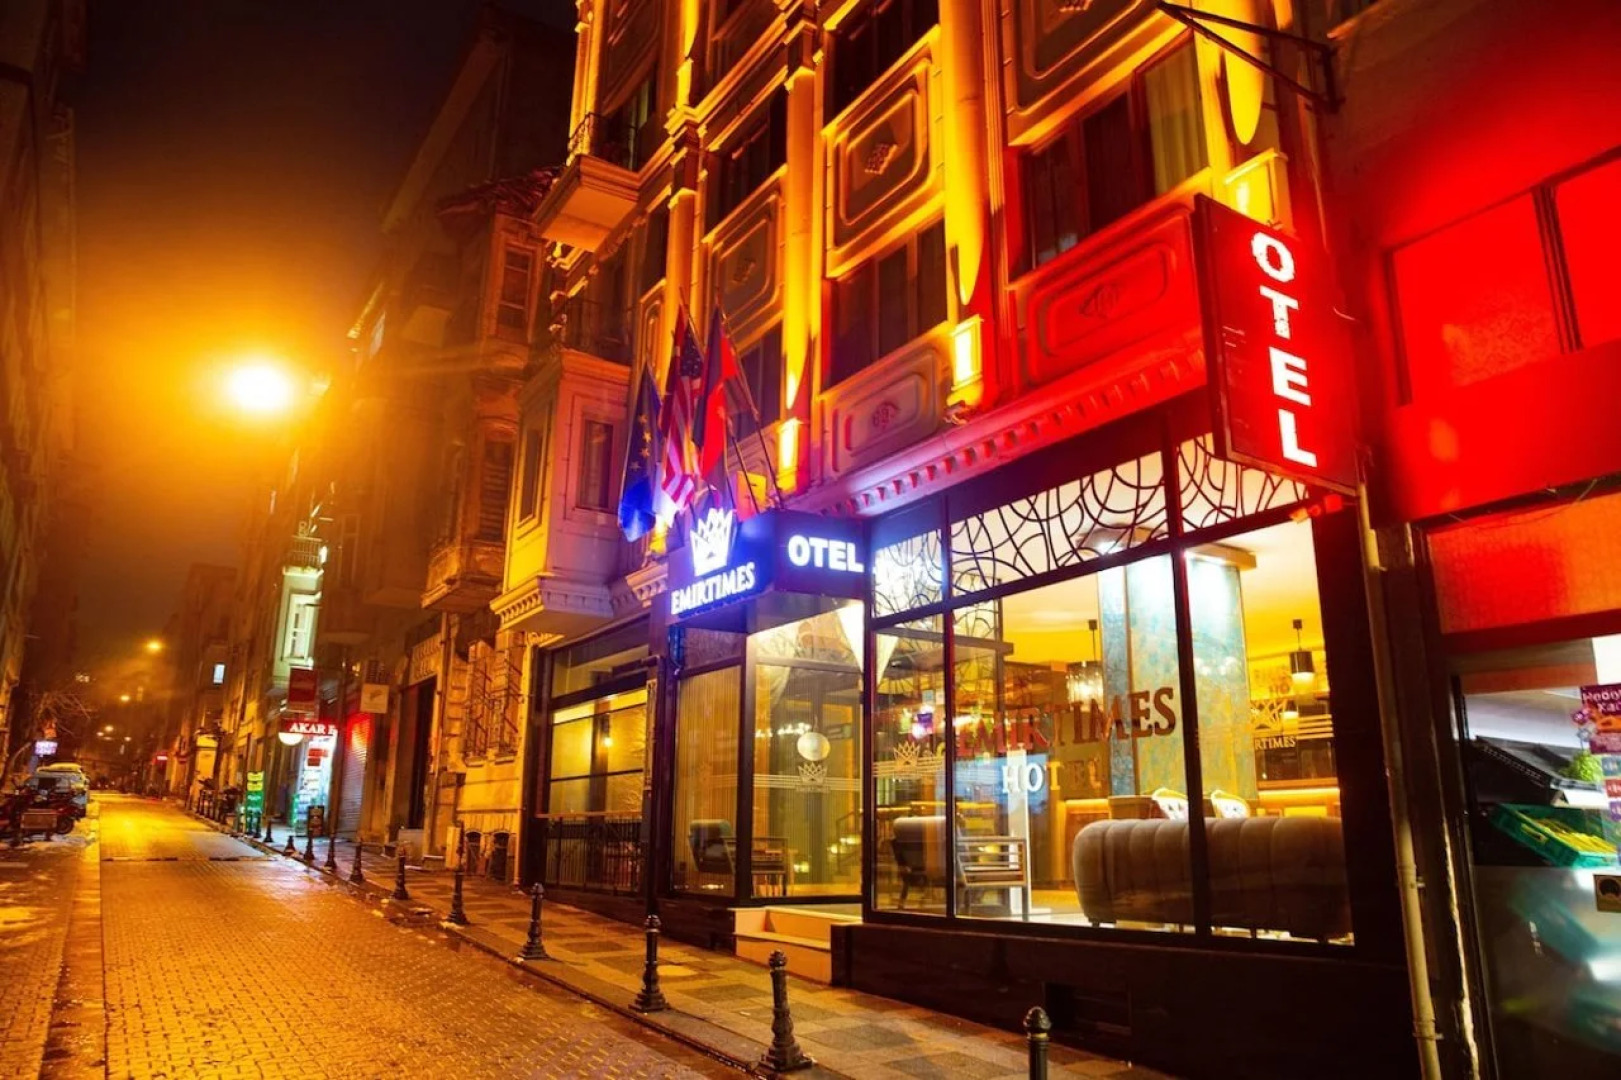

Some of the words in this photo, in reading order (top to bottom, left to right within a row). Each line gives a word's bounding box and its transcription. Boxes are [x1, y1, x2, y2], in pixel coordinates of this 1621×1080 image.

[1251, 231, 1317, 467] OTEL
[788, 534, 865, 573] OTEL
[671, 562, 756, 615] EMIRTIMES
[289, 722, 326, 734] AKAR
[955, 687, 1177, 757] EMIRTIMES
[1002, 759, 1102, 794] HOTEL
